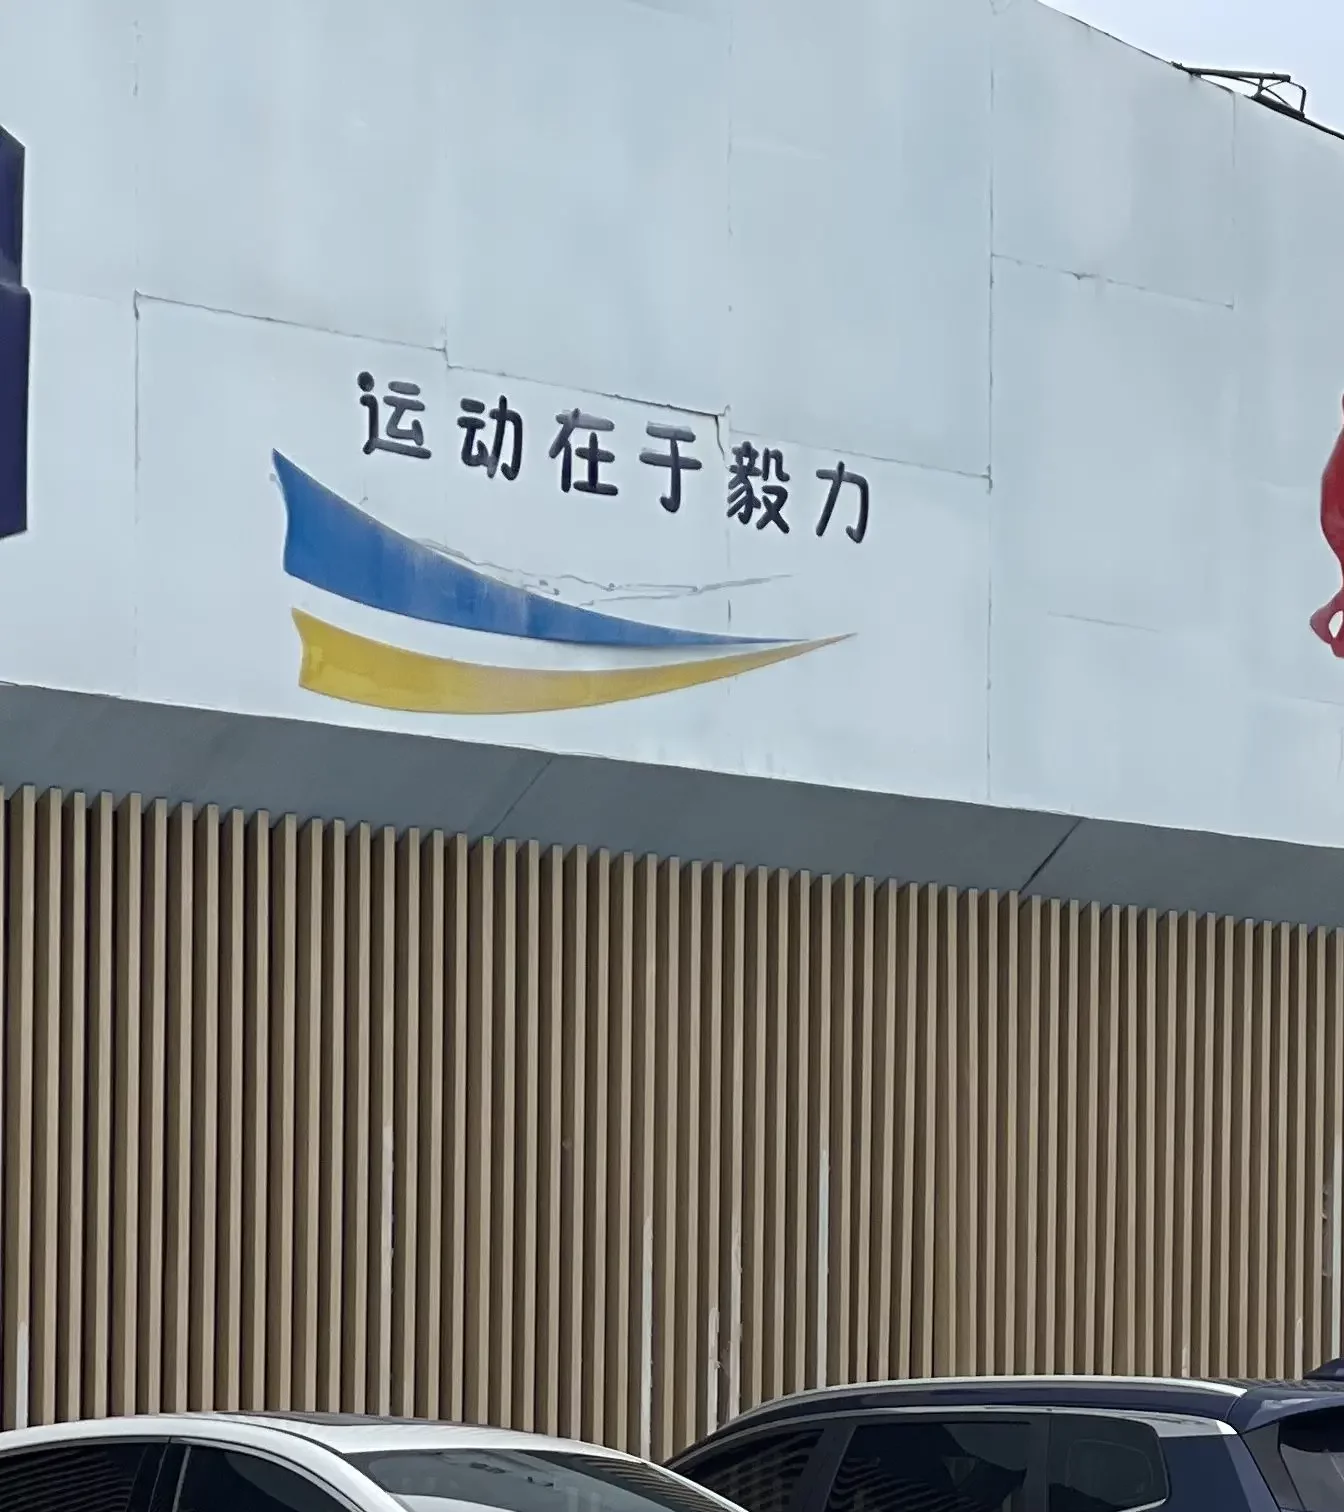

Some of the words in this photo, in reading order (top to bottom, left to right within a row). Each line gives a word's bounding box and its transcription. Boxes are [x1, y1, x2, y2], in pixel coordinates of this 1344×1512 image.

[357, 371, 870, 544] 运动在于毅力
